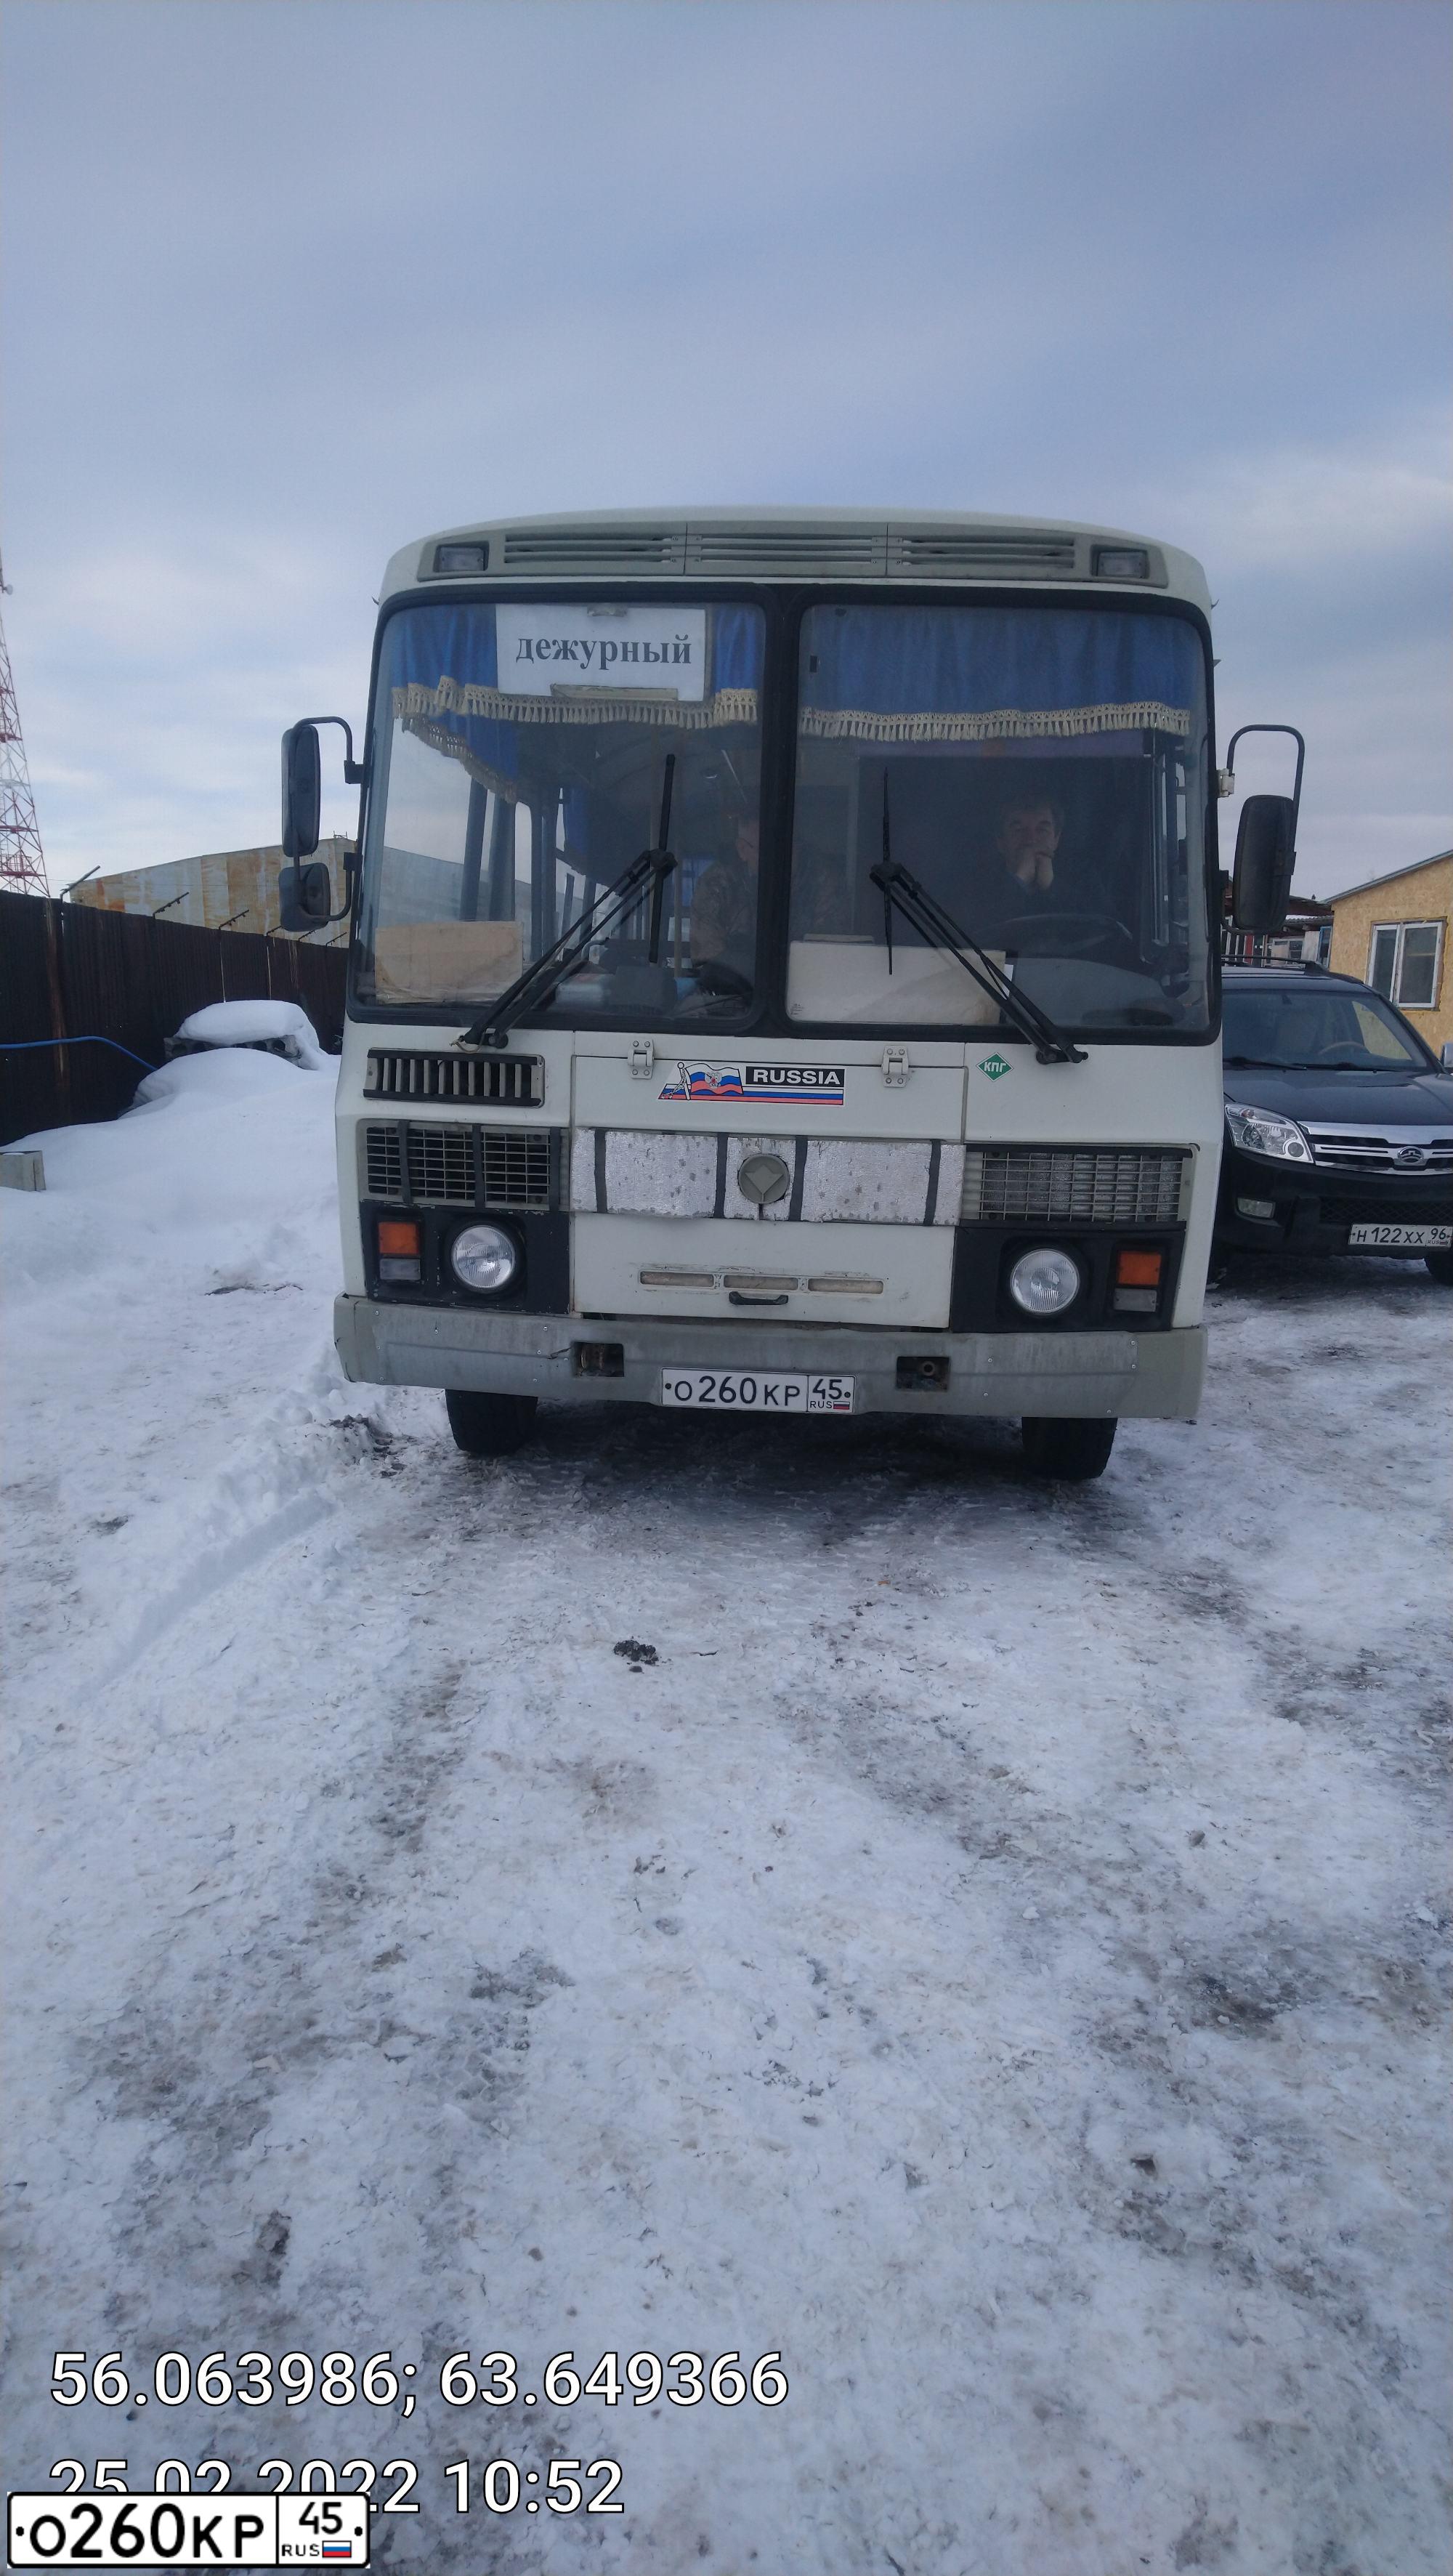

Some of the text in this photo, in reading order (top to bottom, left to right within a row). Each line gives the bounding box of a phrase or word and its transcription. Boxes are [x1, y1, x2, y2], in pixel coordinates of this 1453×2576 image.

[515, 634, 692, 671] дежурный
[984, 1061, 1007, 1073] КПГ
[753, 1068, 841, 1086] RUSSIA
[1430, 1227, 1446, 1240] 96
[812, 1378, 843, 1400] 45
[809, 1400, 833, 1409] RUS
